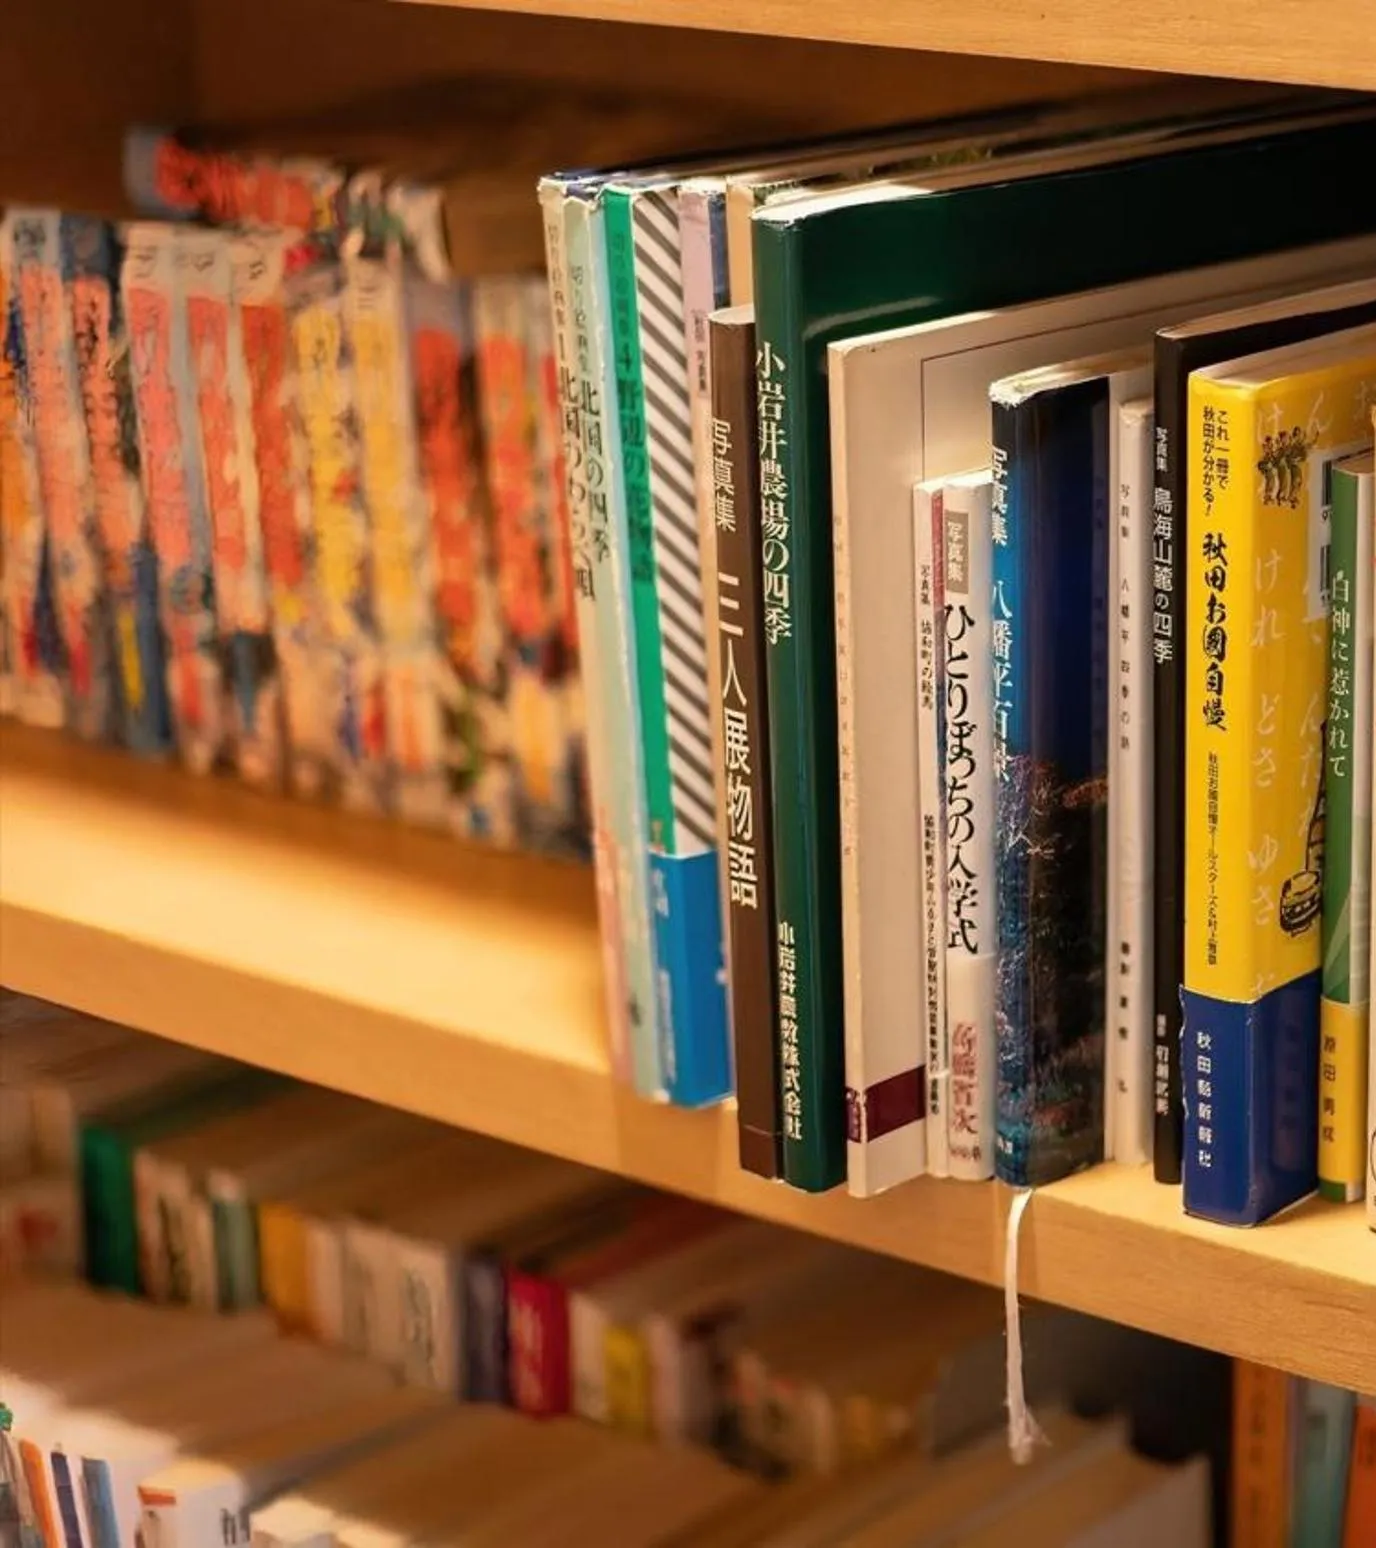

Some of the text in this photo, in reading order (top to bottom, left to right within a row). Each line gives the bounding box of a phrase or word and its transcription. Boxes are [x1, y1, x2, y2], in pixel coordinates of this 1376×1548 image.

[755, 341, 792, 646] 小岩井農場の四季
[1216, 410, 1230, 490] これ一冊で
[712, 418, 758, 910] 写真集 三人展物語
[944, 603, 978, 955] ひとりぼっちの入学式
[1328, 571, 1351, 777] 白神に惹かれて
[1197, 1031, 1212, 1168] 秋田魁新報社
